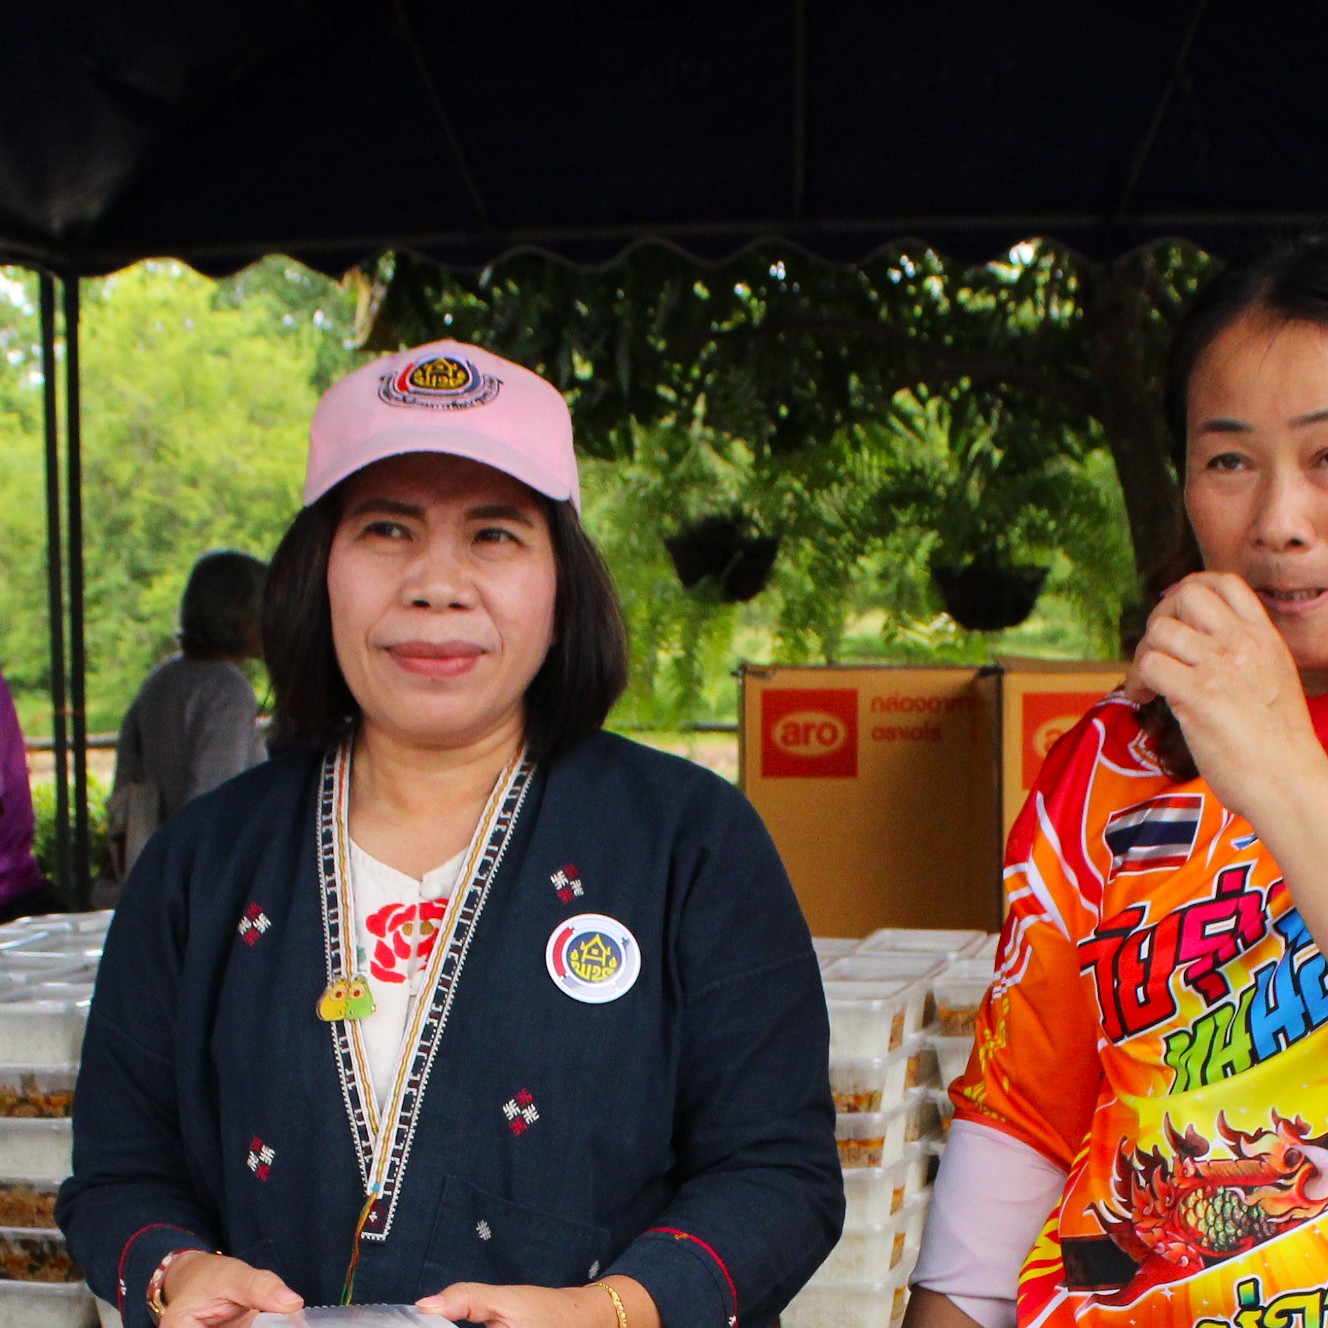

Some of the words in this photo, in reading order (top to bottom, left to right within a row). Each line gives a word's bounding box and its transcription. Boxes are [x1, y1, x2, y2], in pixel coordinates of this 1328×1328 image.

[780, 719, 840, 745] aro
[1078, 864, 1285, 1043] วัยรุ่
